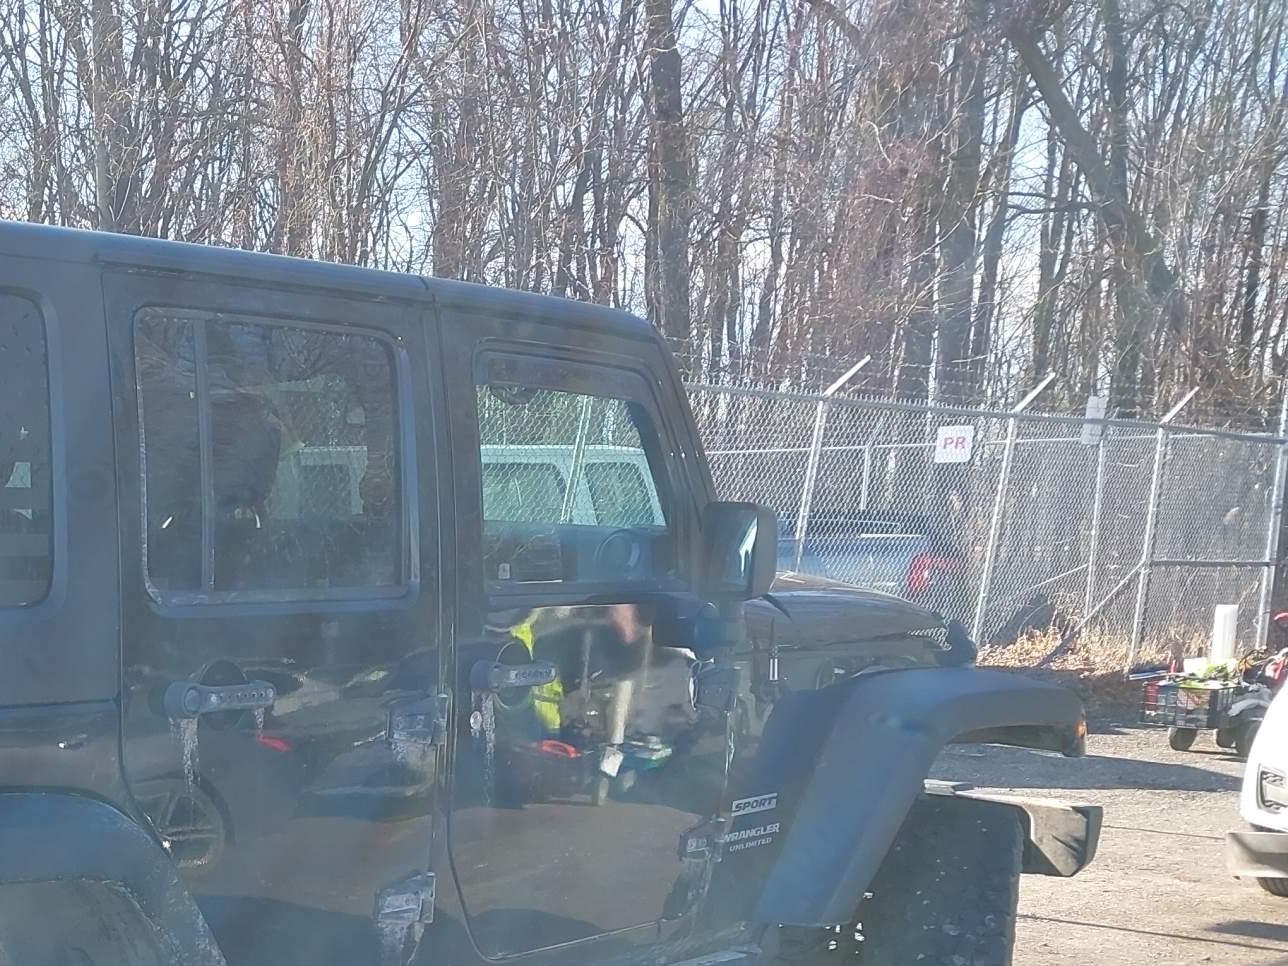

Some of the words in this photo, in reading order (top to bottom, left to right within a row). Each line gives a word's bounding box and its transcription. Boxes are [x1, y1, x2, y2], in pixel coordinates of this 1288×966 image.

[943, 436, 966, 450] PR
[735, 798, 773, 813] SPORT
[729, 837, 772, 851] UNLIMITED
